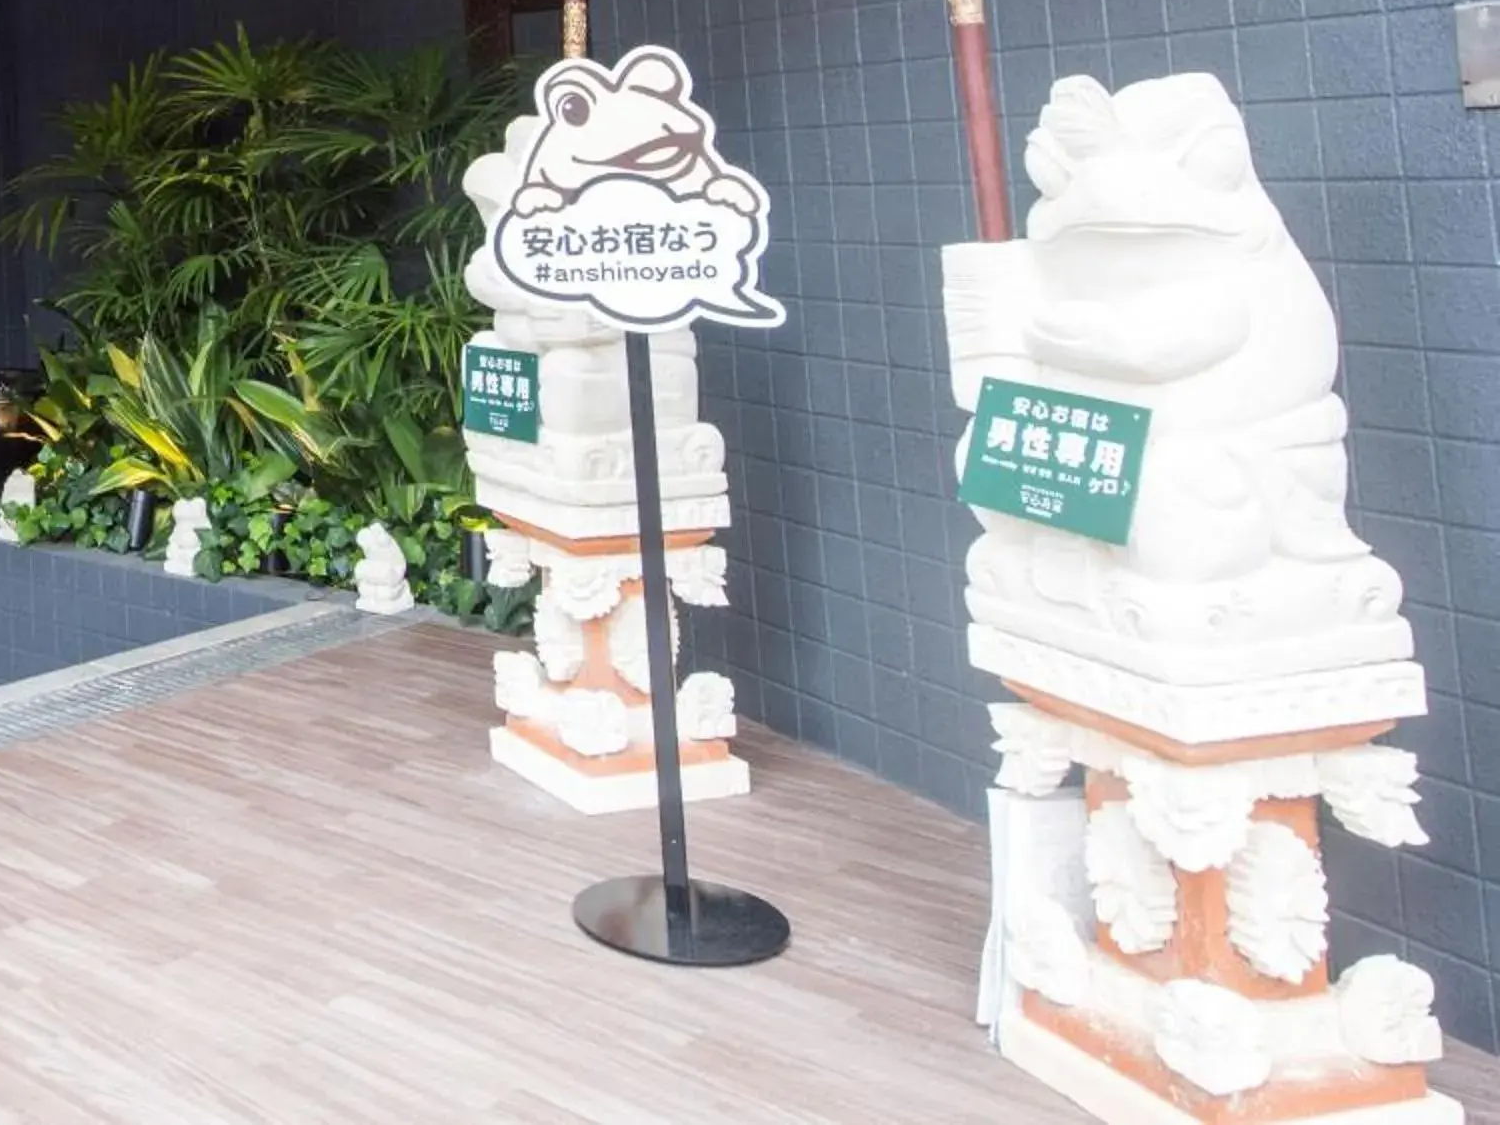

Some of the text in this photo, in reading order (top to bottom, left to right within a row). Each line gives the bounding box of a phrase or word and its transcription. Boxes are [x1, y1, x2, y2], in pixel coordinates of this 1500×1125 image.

[522, 221, 719, 258] 安心お宿なう
[534, 259, 719, 283] #anshinoyado
[1012, 396, 1109, 432] 安心お宿は
[986, 416, 1125, 477] 男性専用
